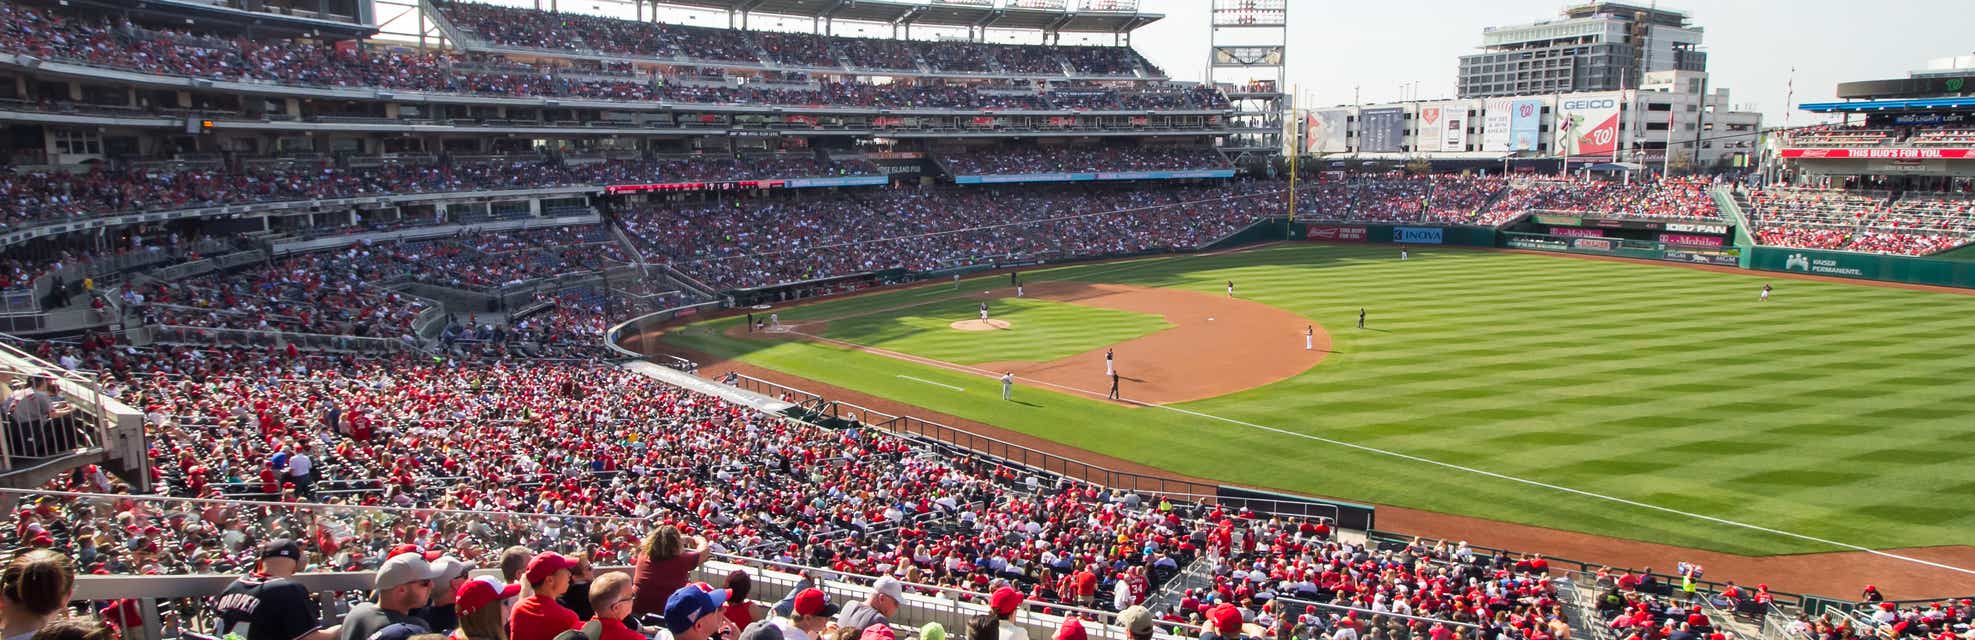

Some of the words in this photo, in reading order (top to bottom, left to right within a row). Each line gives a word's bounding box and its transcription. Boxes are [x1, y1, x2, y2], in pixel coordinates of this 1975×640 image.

[1564, 99, 1614, 110] GEICO
[1848, 149, 1868, 158] THIS
[1870, 149, 1897, 158] BUD'S
[1900, 149, 1917, 158] FOR
[1921, 149, 1942, 158] YOU.
[1696, 224, 1728, 234] FAN
[1405, 231, 1441, 240] INOVA
[1131, 584, 1143, 594] 34
[217, 594, 260, 614] HARPER
